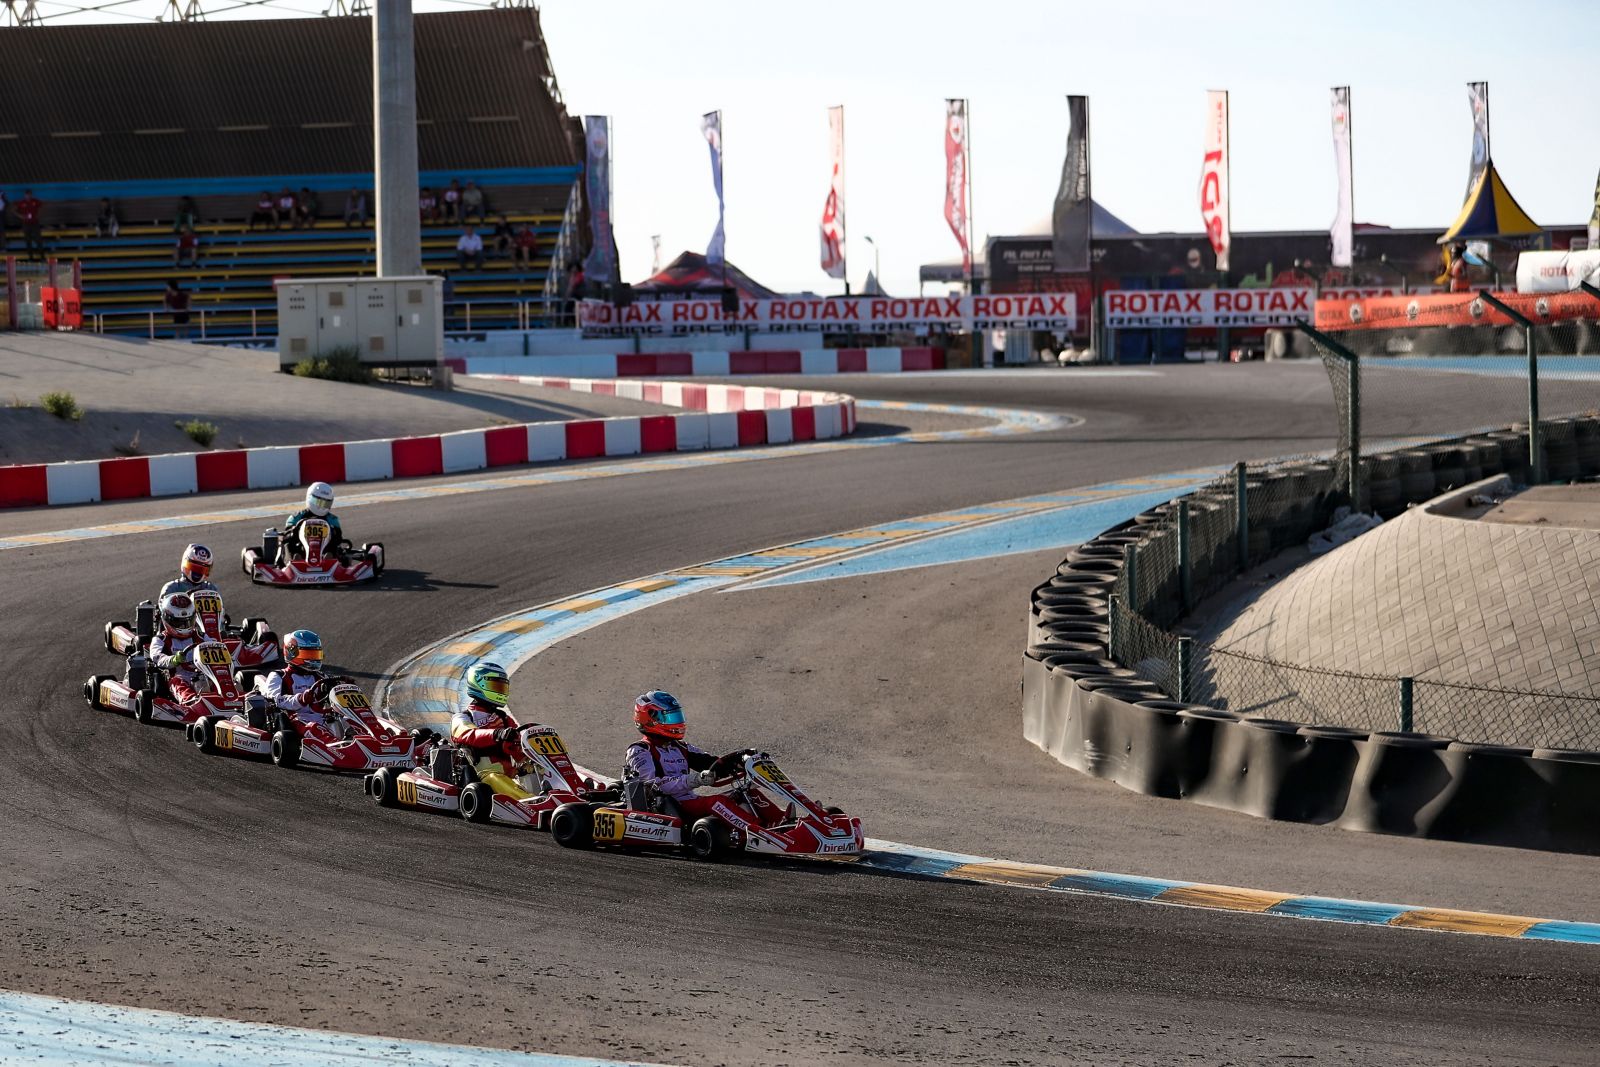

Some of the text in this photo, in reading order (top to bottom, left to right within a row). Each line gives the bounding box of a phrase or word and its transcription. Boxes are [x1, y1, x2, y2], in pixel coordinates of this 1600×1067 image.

[1540, 266, 1574, 277] ROTAX
[1108, 290, 1308, 313] ROTAX ROTAX
[580, 303, 661, 323] OAX
[768, 301, 860, 320] ROTAX
[871, 299, 961, 319] ROTAX
[973, 296, 1067, 317] ROTAX
[768, 322, 860, 332] RACING
[973, 318, 1067, 329] RACING
[1108, 314, 1309, 326] RACING RACING
[307, 526, 323, 536] 305
[196, 600, 218, 612] 303
[203, 650, 227, 663] 304
[343, 694, 368, 707] 308
[234, 736, 260, 749] birelART
[535, 737, 564, 753] 310
[371, 760, 411, 769] birelART
[399, 780, 413, 802] 310
[418, 792, 447, 805] birelART
[715, 803, 749, 829] birelART
[594, 813, 616, 838] 355
[628, 824, 670, 838] birelART
